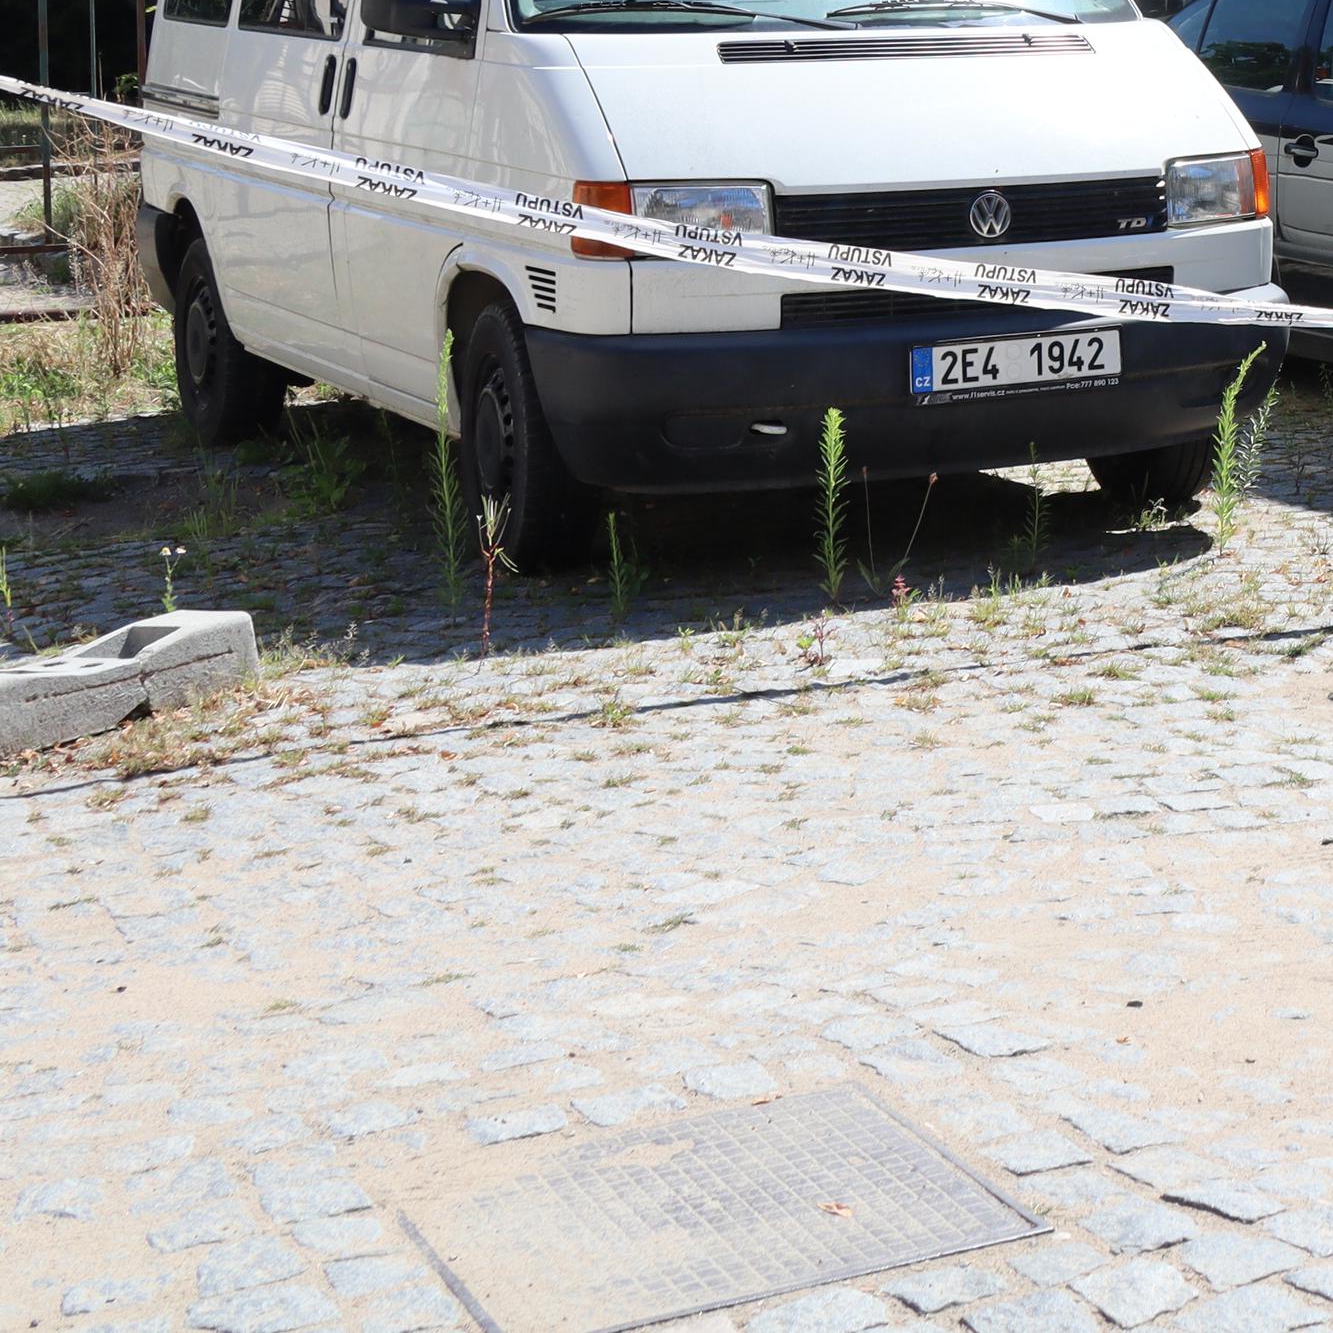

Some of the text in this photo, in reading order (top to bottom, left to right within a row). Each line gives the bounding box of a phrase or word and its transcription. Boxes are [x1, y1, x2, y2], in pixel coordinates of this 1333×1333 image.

[354, 157, 427, 185] VSTUPU
[515, 192, 584, 220] VSTUPU
[674, 223, 743, 247] VSTUPU
[828, 243, 892, 267] VSTUPU
[973, 262, 1037, 284] VSTUPU
[977, 283, 1032, 306] ZÁKAZ
[1114, 278, 1175, 299] VSTUPU
[1118, 298, 1172, 321] ZÁKAZ
[939, 336, 1106, 386] 2E4 1942
[914, 376, 932, 388] CZ
